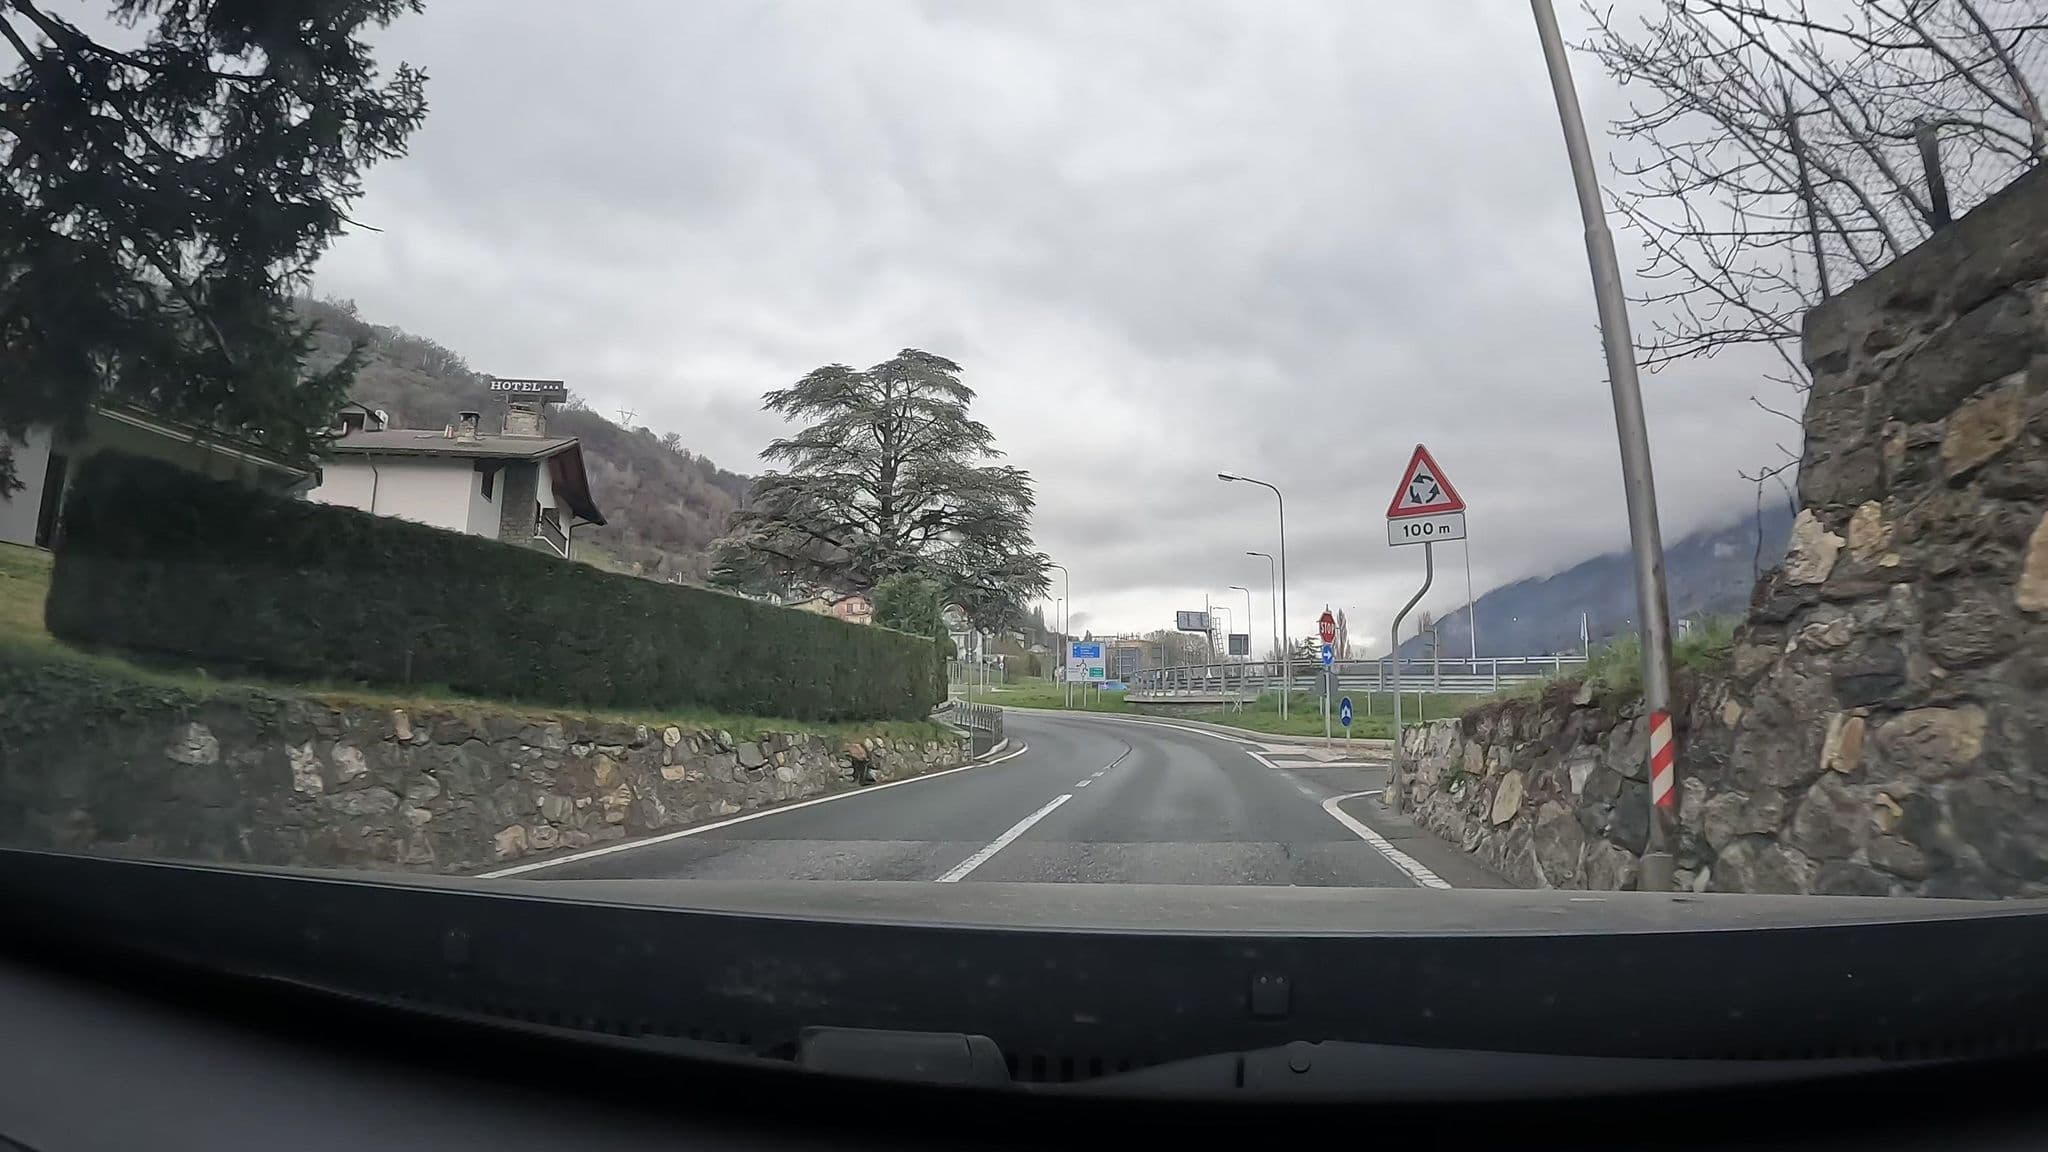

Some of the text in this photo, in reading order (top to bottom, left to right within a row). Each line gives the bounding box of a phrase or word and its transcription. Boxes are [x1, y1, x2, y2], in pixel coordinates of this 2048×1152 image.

[490, 381, 541, 392] HOTEL
[1403, 522, 1450, 537] 100 m
[1321, 622, 1334, 635] STOP
